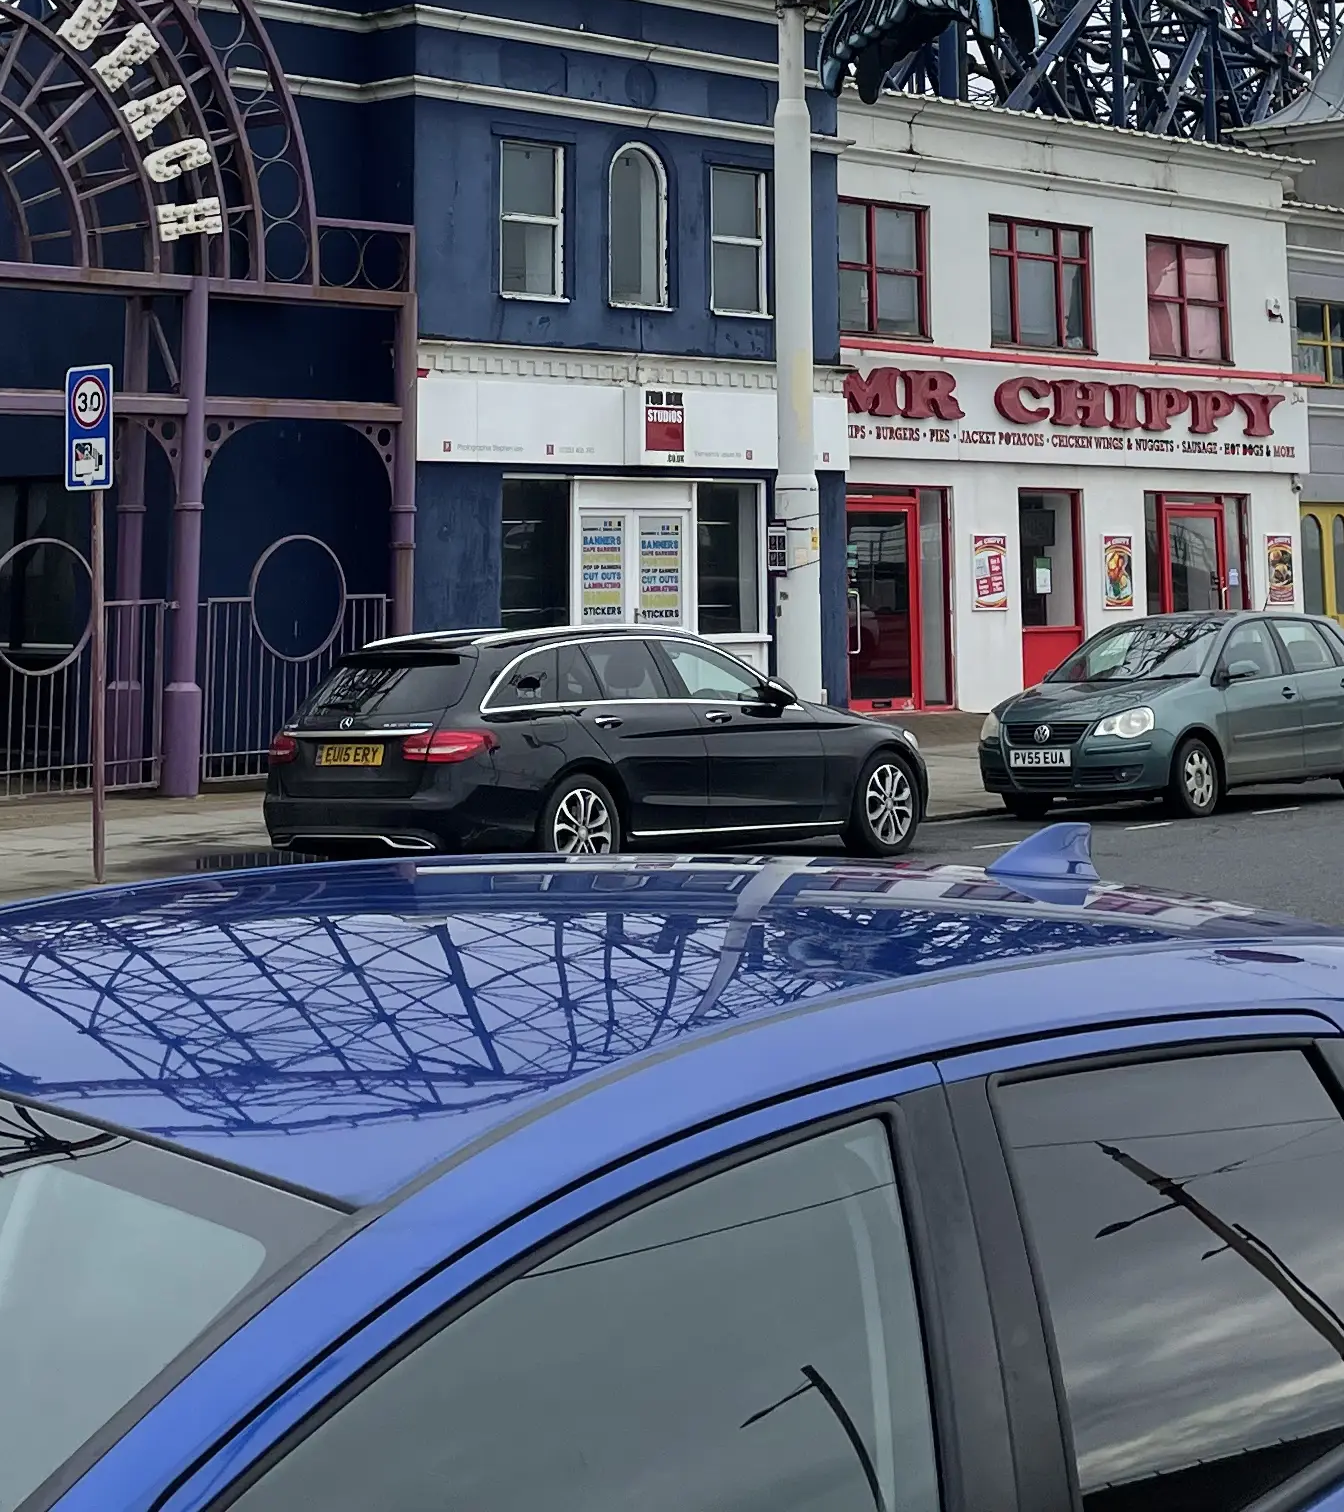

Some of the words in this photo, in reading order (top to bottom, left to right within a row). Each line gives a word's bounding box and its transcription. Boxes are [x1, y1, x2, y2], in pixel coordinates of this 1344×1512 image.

[77, 391, 101, 413] 30
[843, 367, 965, 420] MR
[994, 377, 1286, 437] CHIPPY
[875, 426, 920, 442] BURGERS
[929, 429, 950, 443] PIES
[959, 430, 996, 445] JACKET
[998, 432, 1045, 447] POTATOES
[1051, 435, 1092, 449] CHICKEN
[1094, 436, 1124, 451] WINGS
[1127, 439, 1133, 451] &
[1135, 439, 1174, 453] NUGGETS
[1181, 440, 1218, 455] SAUSAGE
[1224, 443, 1240, 456] HOT
[1242, 444, 1264, 457] DOGS
[583, 536, 622, 546] BANNERS
[641, 540, 679, 550] BANNERS
[583, 572, 599, 581] CUT
[601, 572, 622, 581] OUTS
[642, 576, 657, 584] CUT
[659, 575, 679, 584] OUTS
[583, 607, 622, 616] STICKERS
[641, 610, 680, 618] STICKERS
[325, 747, 350, 763] EU15
[352, 746, 379, 763] ERY
[1014, 752, 1041, 765] PV55
[1043, 752, 1065, 764] EUA
